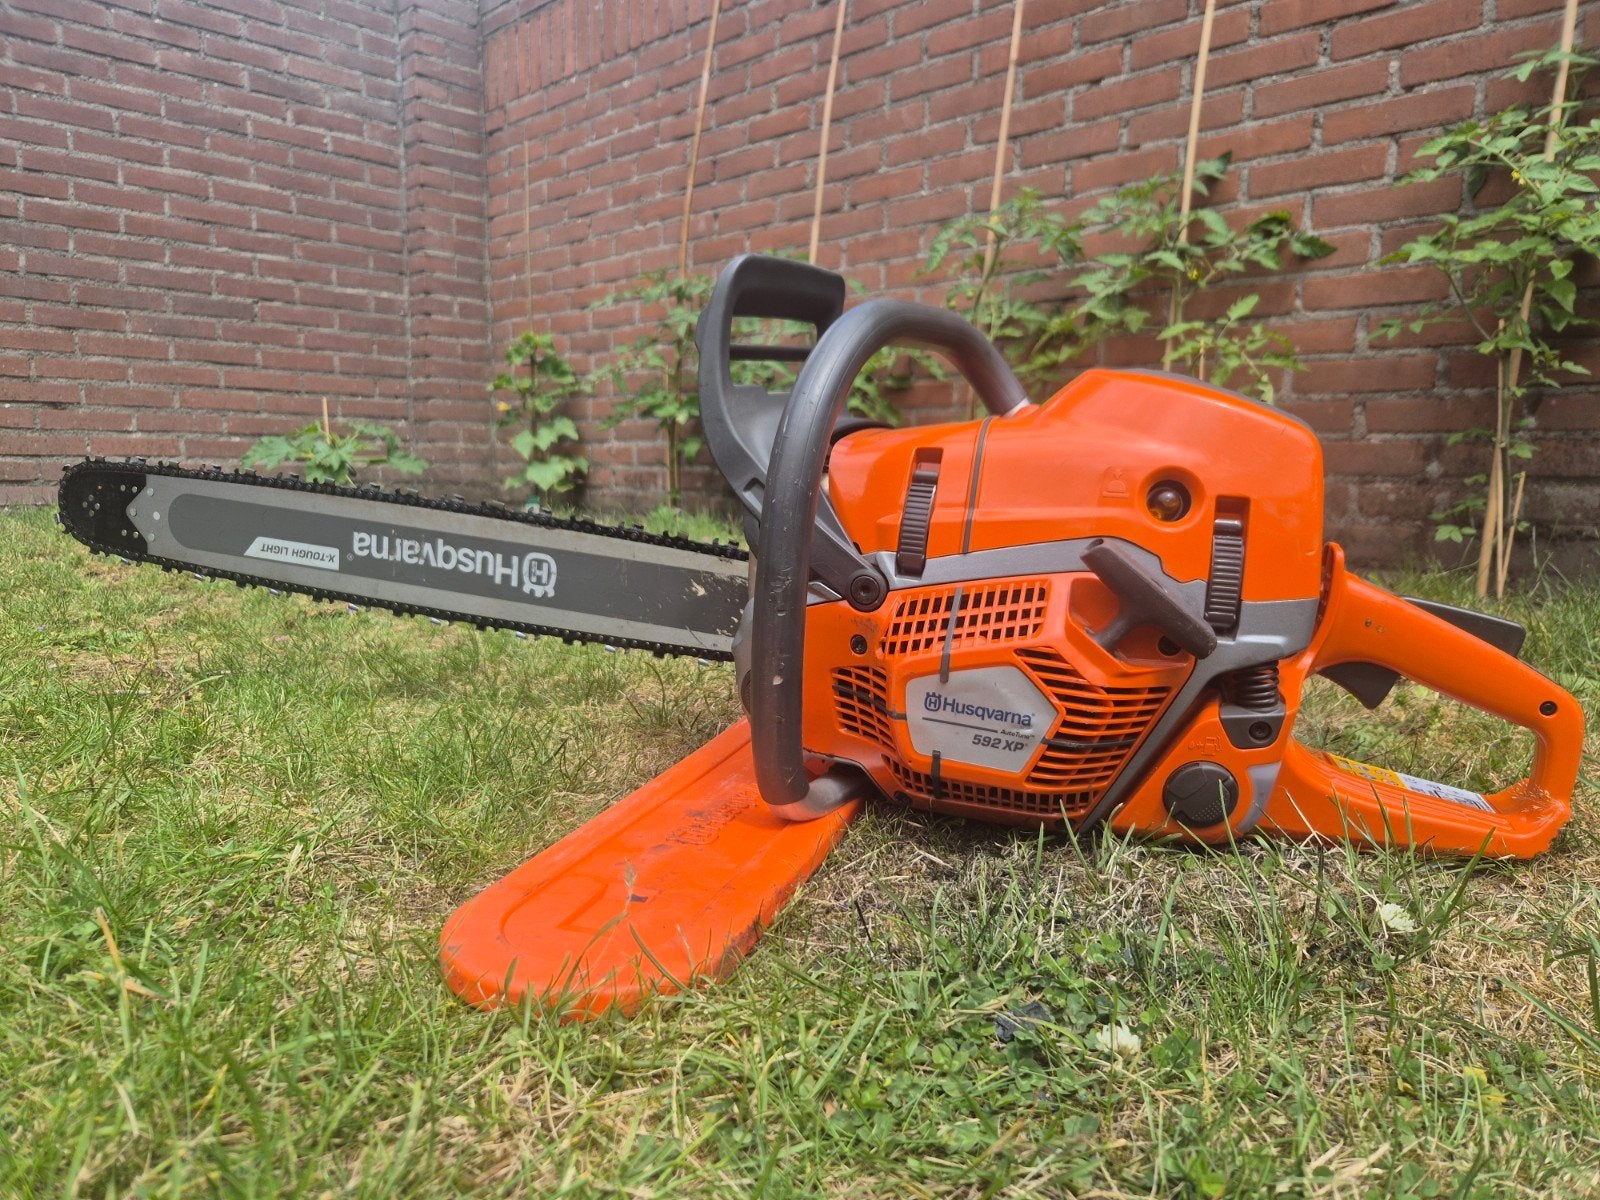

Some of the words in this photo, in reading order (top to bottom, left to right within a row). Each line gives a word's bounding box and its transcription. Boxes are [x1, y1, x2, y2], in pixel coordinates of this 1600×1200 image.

[260, 543, 289, 556] LIGHT
[291, 548, 336, 564] X-TOUGH
[353, 531, 519, 587] Husqvarna
[942, 697, 1032, 726] Husqvarna
[972, 734, 1002, 749] 592
[1003, 740, 1025, 752] XP
